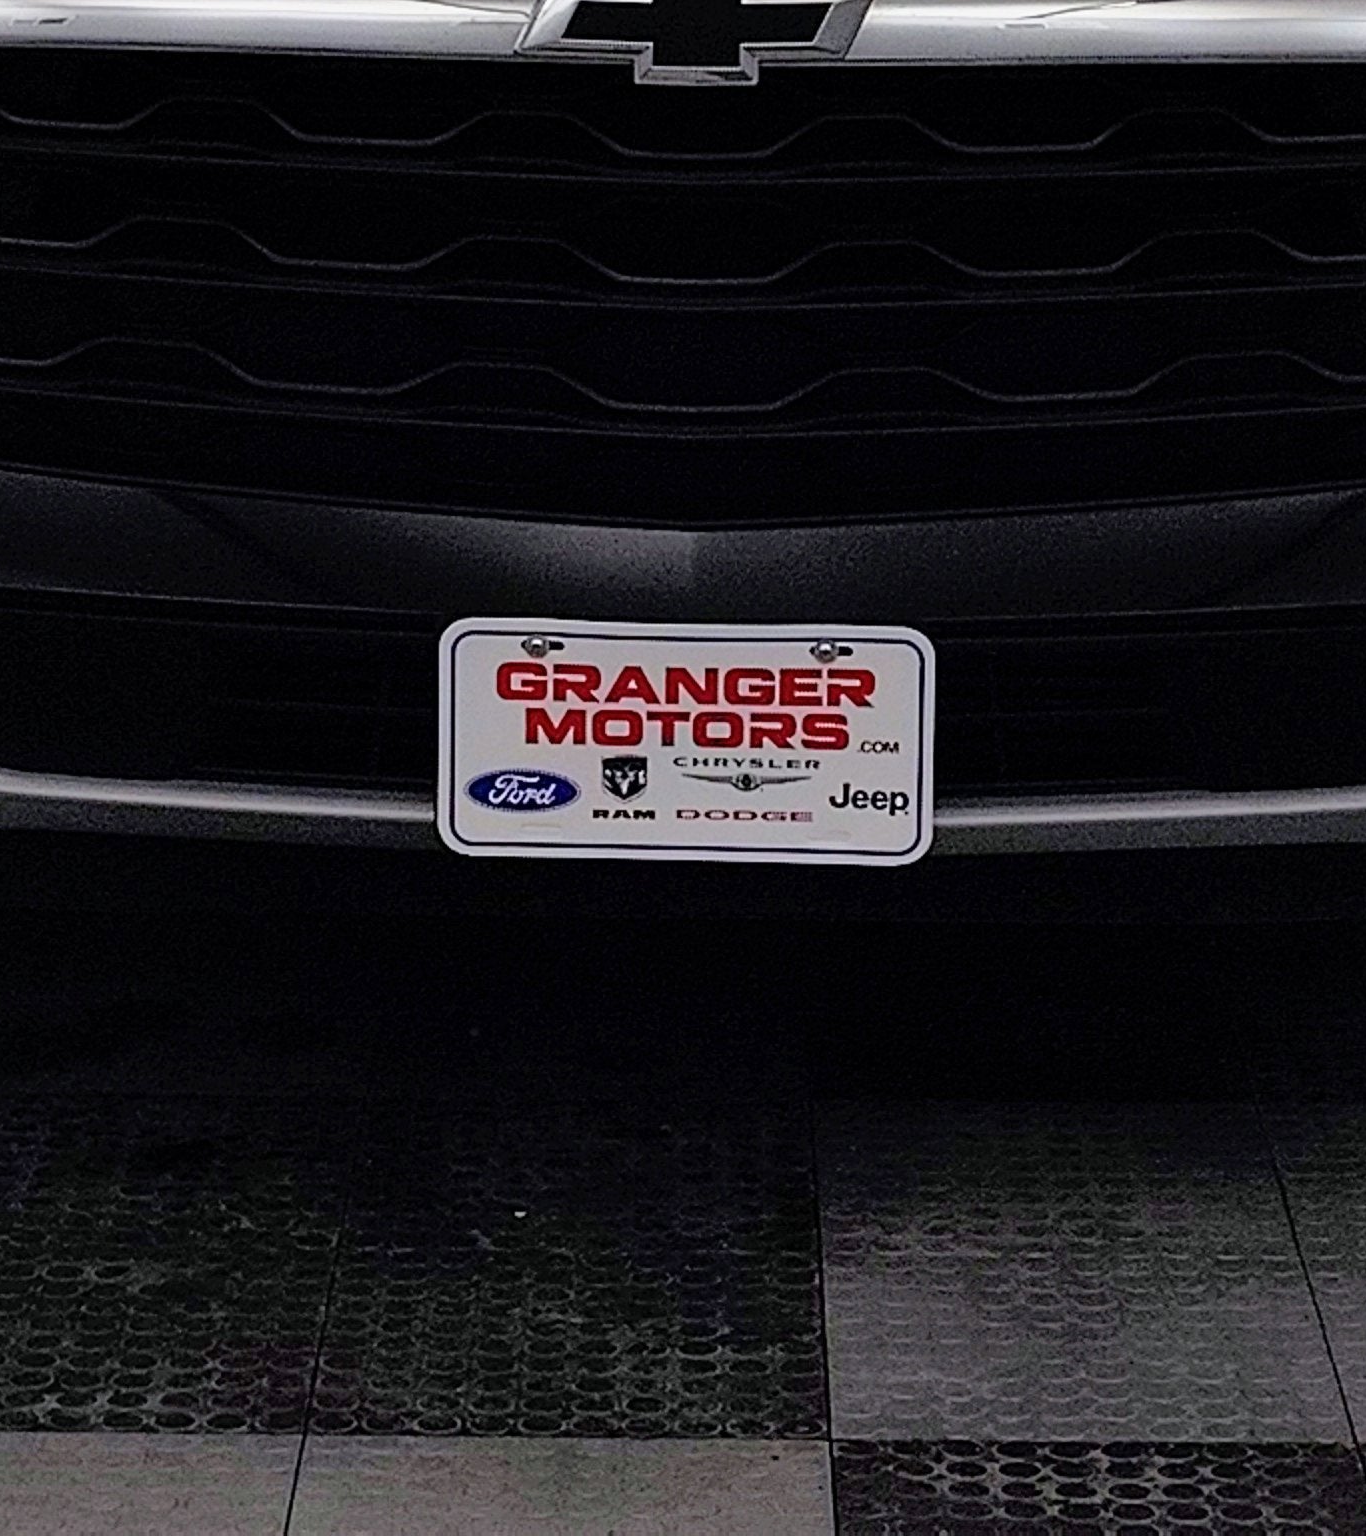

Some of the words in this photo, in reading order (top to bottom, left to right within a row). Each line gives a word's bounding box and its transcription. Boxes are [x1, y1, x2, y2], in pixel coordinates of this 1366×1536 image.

[496, 662, 876, 708] GRANGER
[525, 708, 850, 751] MOTORS
[673, 757, 821, 770] CHRYSLER
[488, 776, 556, 807] Ford
[829, 783, 910, 817] Jeep
[592, 809, 656, 820] RAM
[676, 809, 814, 822] DODGE
